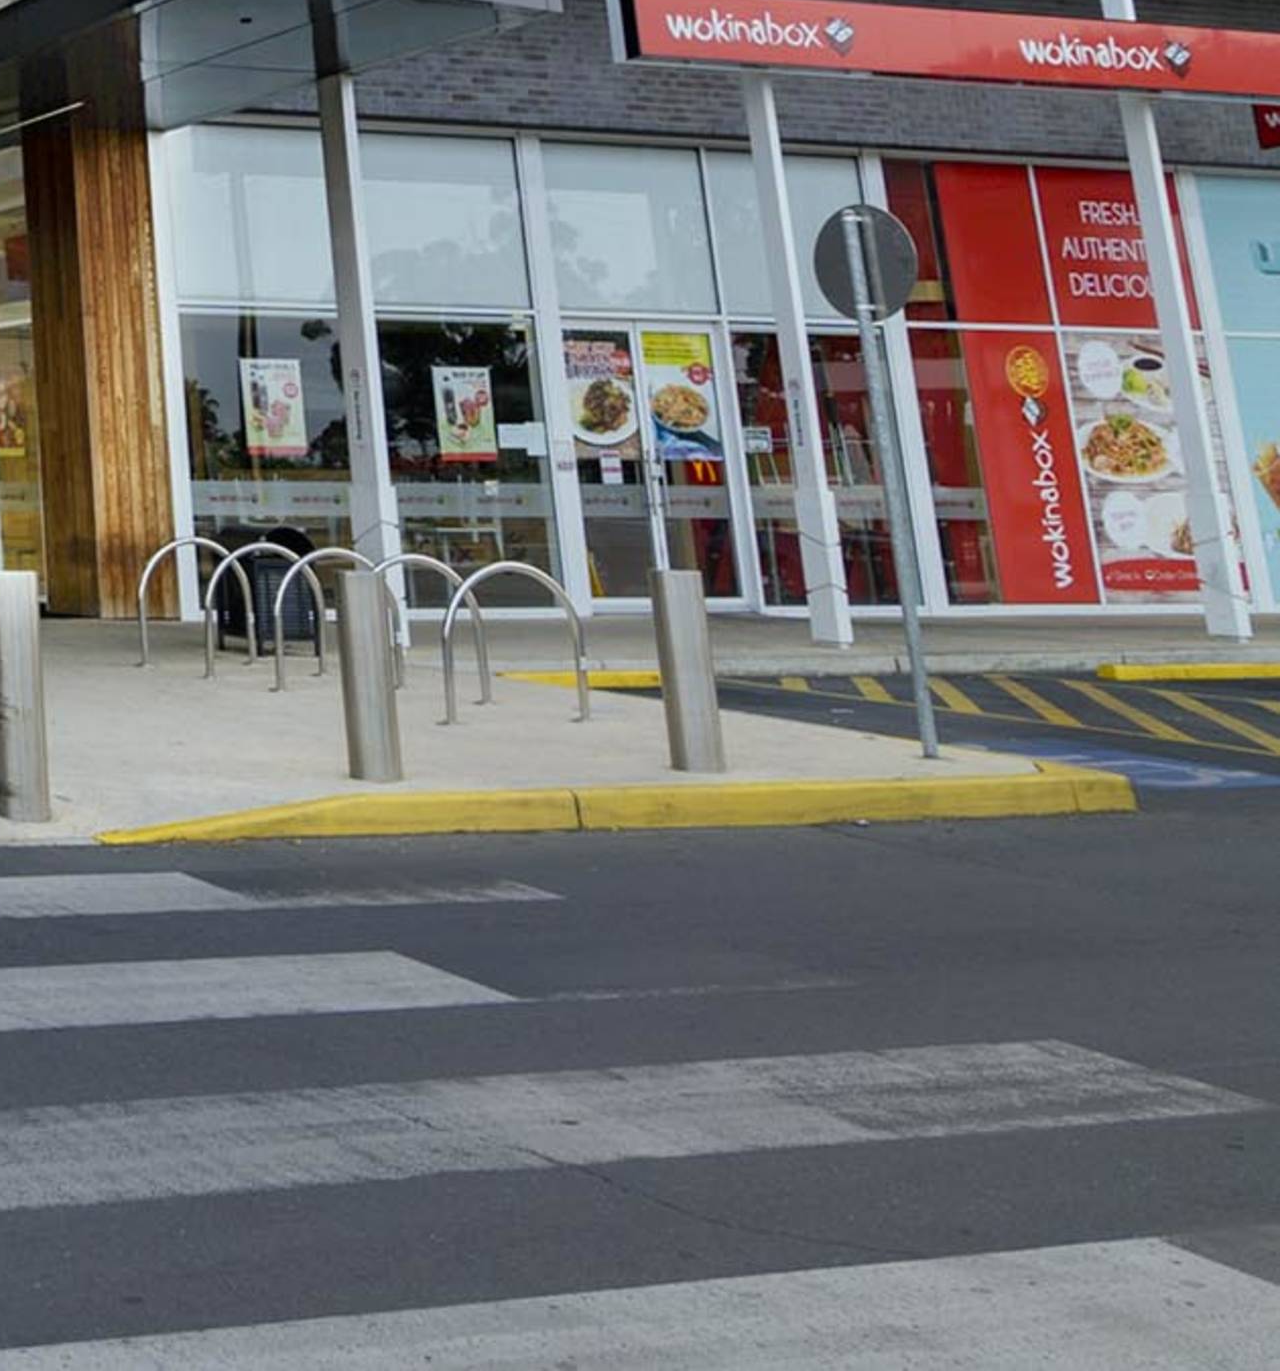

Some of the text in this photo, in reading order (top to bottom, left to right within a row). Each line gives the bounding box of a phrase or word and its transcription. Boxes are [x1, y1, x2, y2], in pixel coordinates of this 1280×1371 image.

[666, 10, 821, 48] wokinabox
[1020, 34, 1162, 71] wokinabox
[1061, 236, 1145, 262] AUTHENT
[1068, 272, 1153, 299] DELICIO
[1030, 429, 1074, 589] wokinabox
